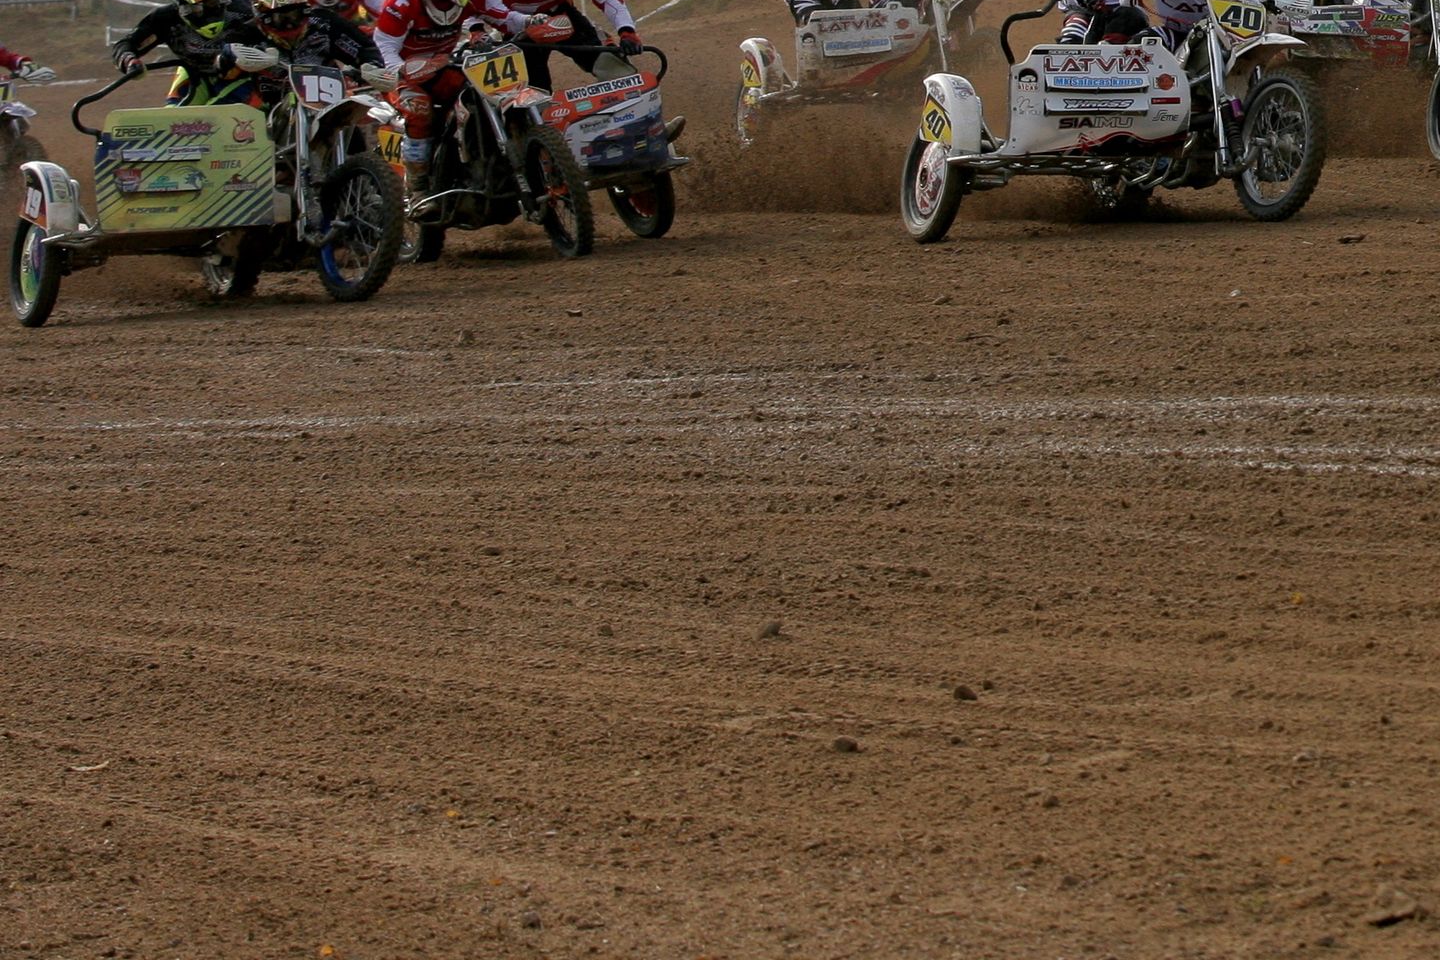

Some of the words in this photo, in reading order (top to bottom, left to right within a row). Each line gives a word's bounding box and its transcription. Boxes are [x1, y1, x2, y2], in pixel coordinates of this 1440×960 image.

[818, 19, 884, 34] LATVIA
[1220, 5, 1262, 31] 40
[483, 55, 518, 88] 44
[1044, 56, 1149, 74] LATVIA
[302, 75, 342, 104] 19
[566, 87, 587, 100] MOTO
[588, 82, 611, 96] CENTER
[613, 75, 642, 91] SCHWYZ
[114, 128, 152, 138] ZABEL
[926, 109, 945, 139] 40
[385, 134, 402, 162] 44
